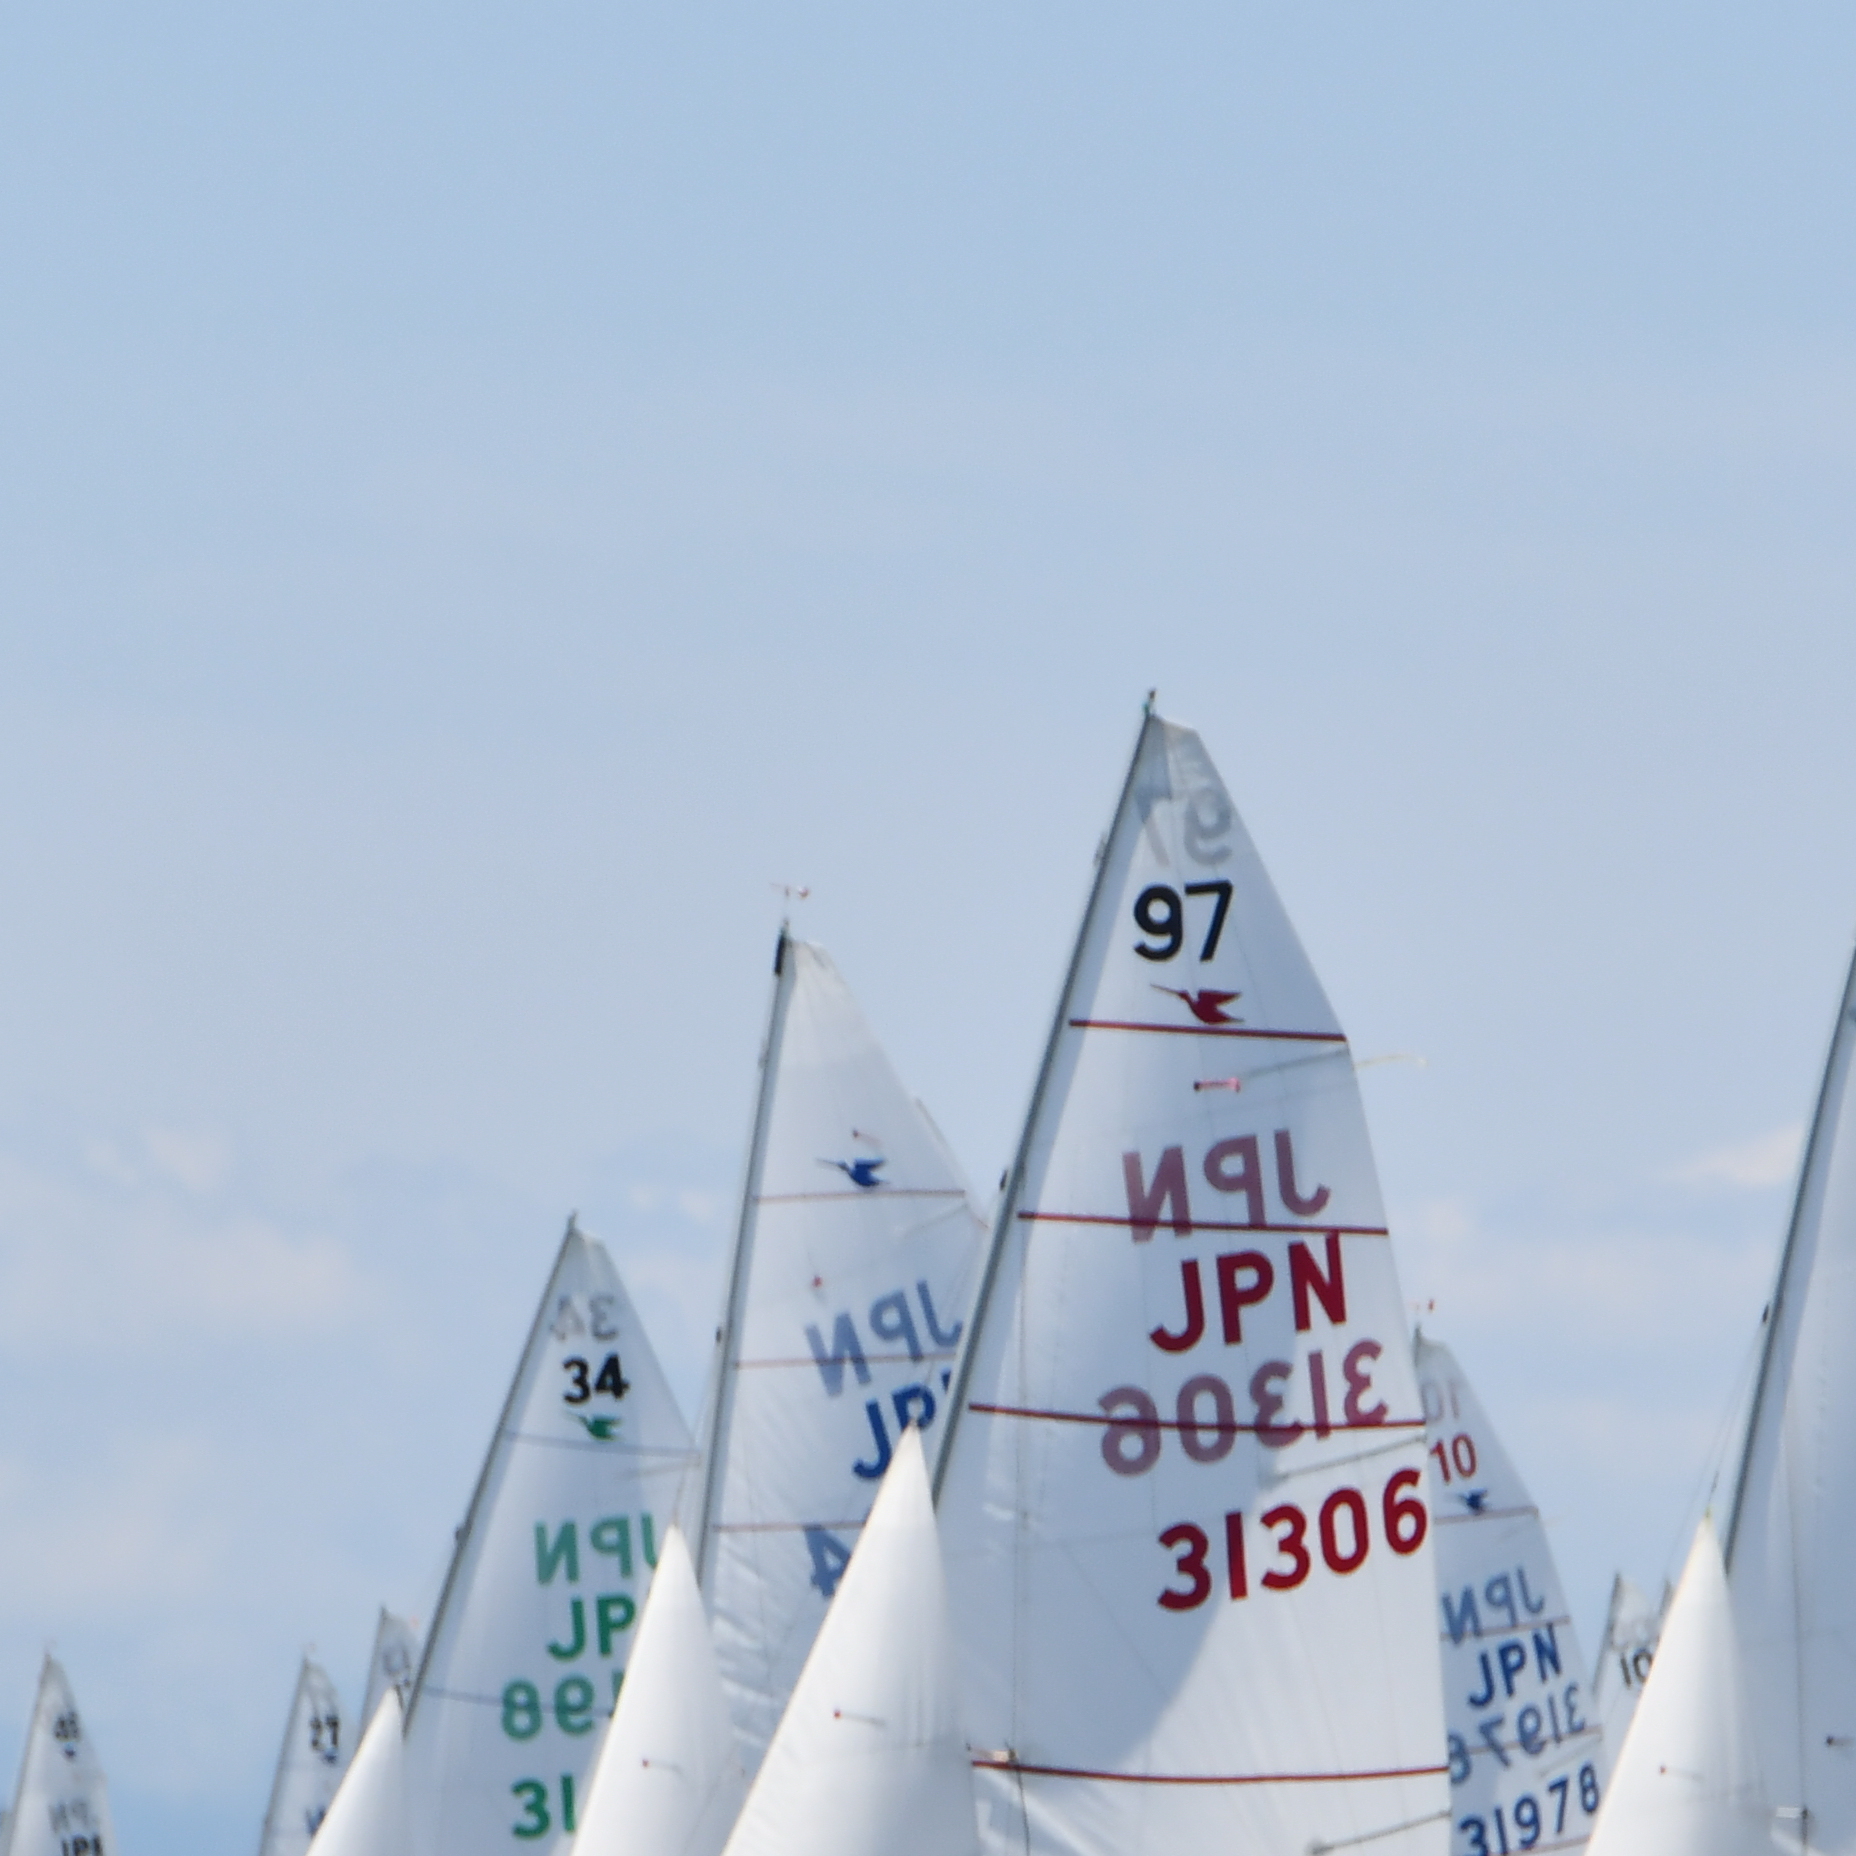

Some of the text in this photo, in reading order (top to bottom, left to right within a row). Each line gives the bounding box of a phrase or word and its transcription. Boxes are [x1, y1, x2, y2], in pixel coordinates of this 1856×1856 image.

[1133, 879, 1235, 963] 97
[1148, 1230, 1347, 1355] JPN
[561, 1352, 630, 1405] 34
[1429, 1432, 1478, 1486] 10
[1156, 1466, 1430, 1613] 31306
[547, 1594, 638, 1662] JP
[1468, 1622, 1563, 1710] JPN
